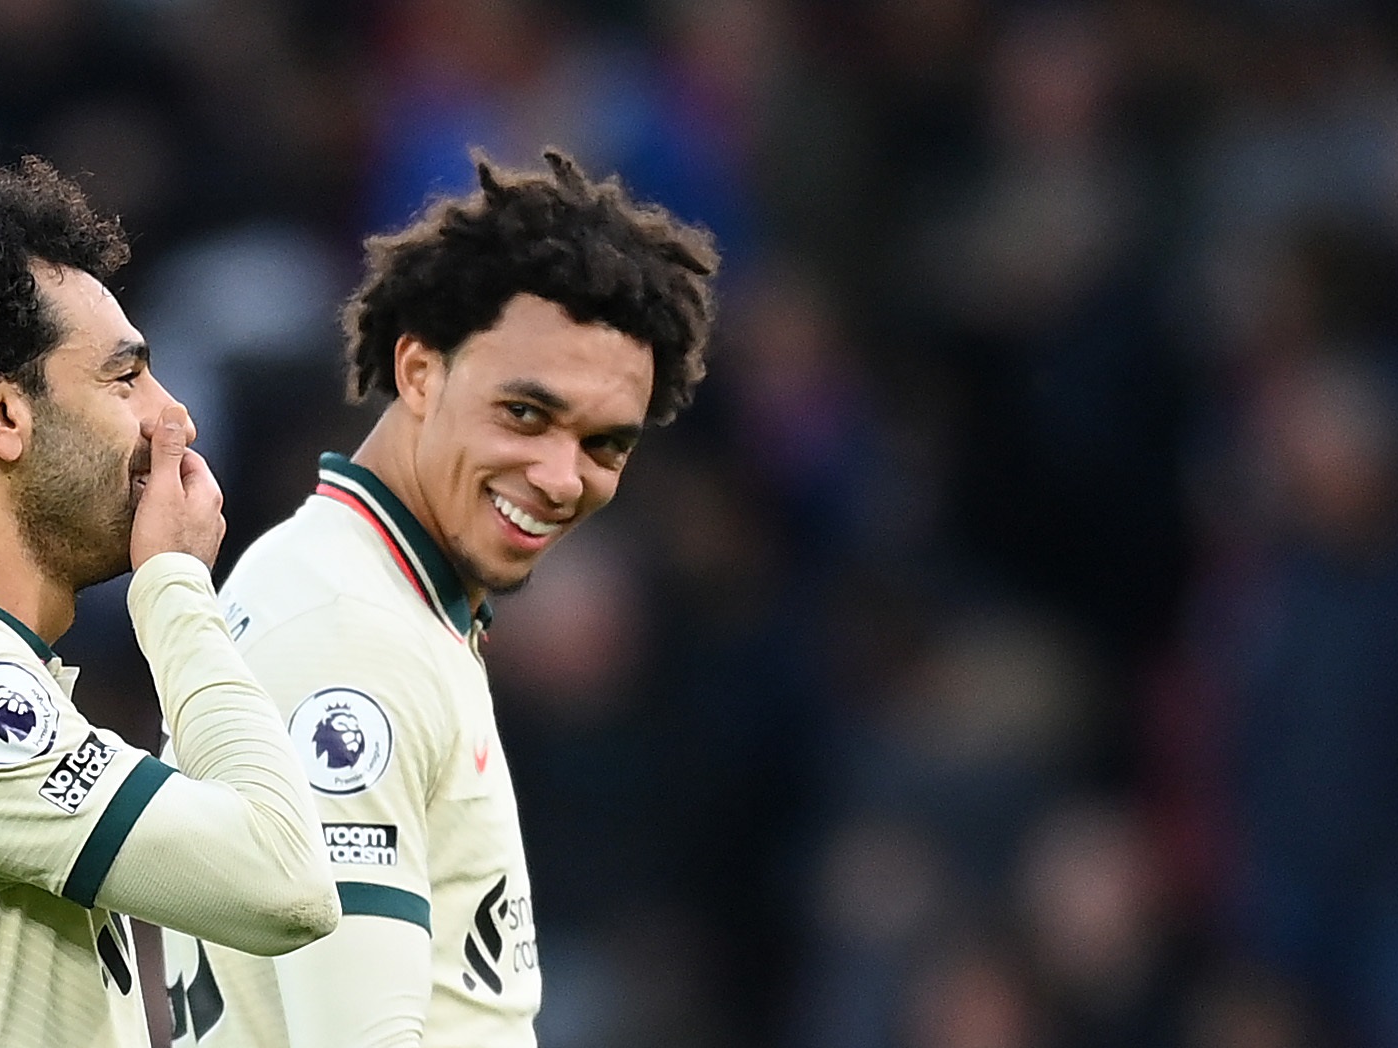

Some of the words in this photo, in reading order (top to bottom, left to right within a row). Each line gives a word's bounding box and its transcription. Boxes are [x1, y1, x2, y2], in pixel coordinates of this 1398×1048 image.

[39, 770, 73, 806] No
[55, 778, 89, 813] for
[325, 826, 387, 847] room
